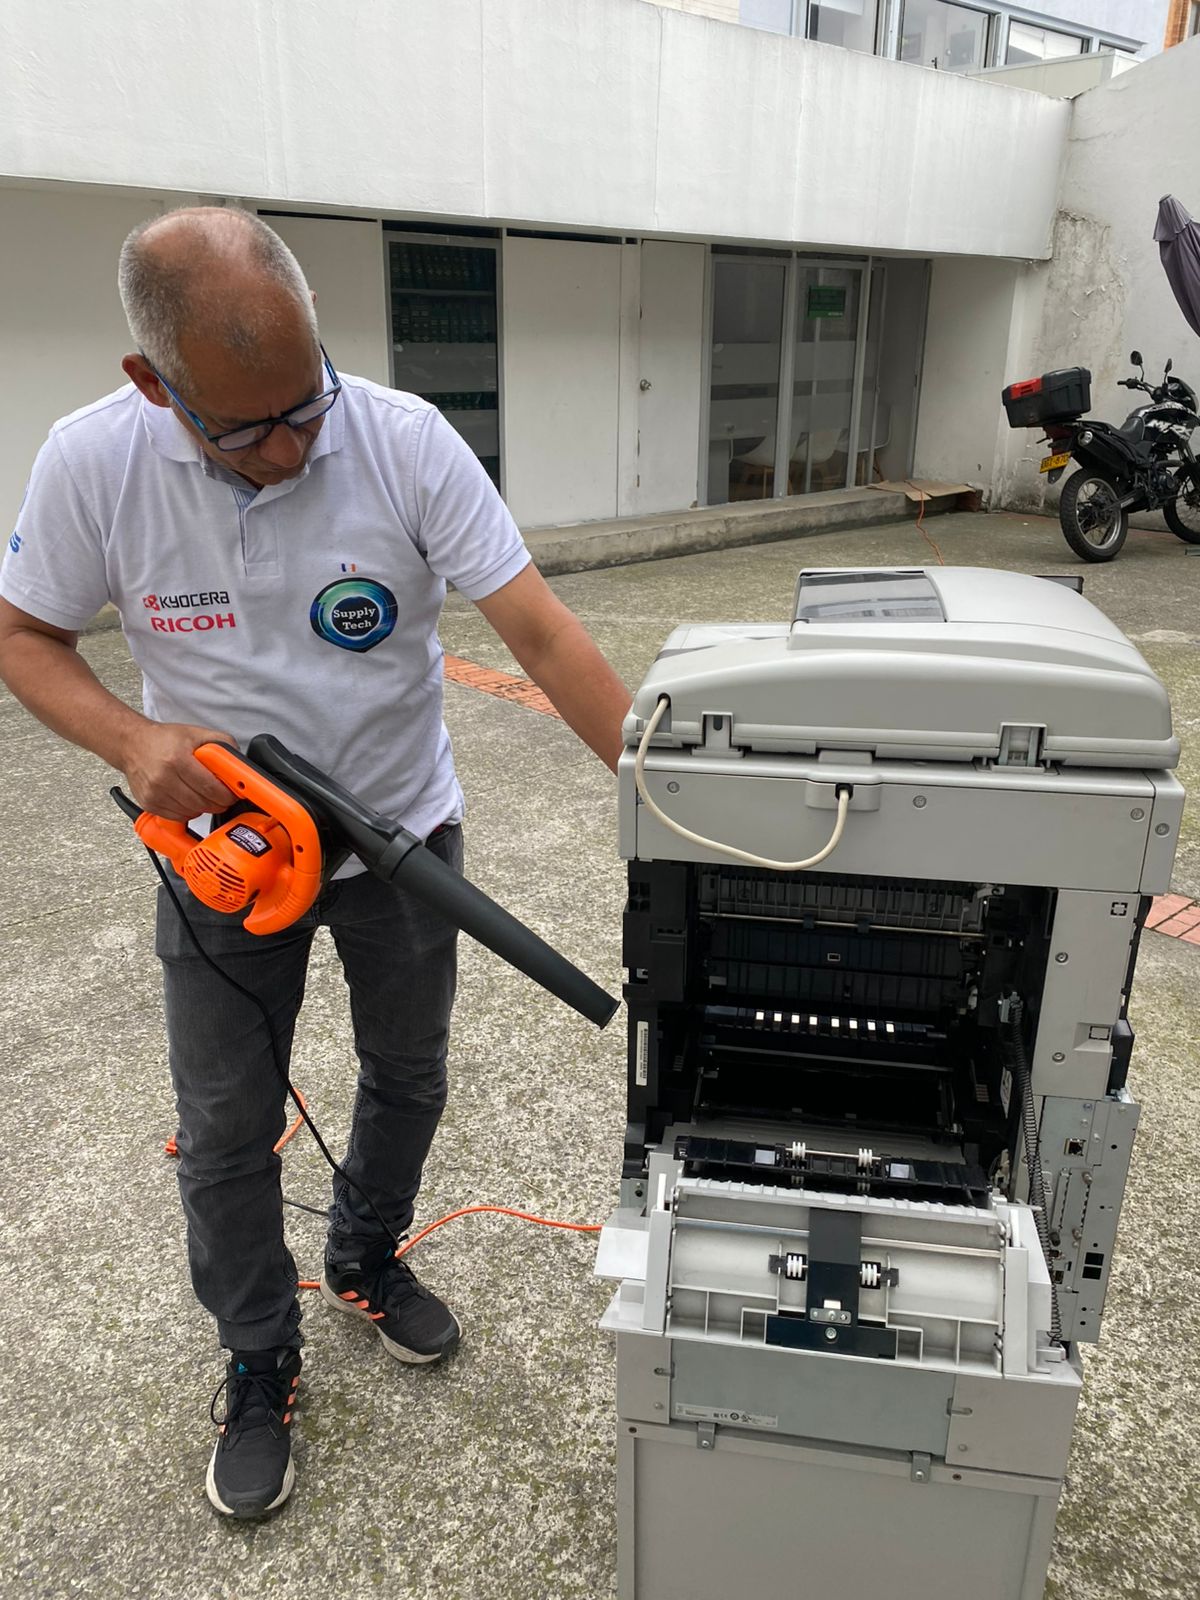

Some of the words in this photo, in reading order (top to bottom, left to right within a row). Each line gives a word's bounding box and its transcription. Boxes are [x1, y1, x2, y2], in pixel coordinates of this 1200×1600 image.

[159, 591, 230, 609] KYOCERA
[333, 606, 377, 621] Supply
[150, 613, 237, 633] RICOH
[342, 619, 372, 631] Tech
